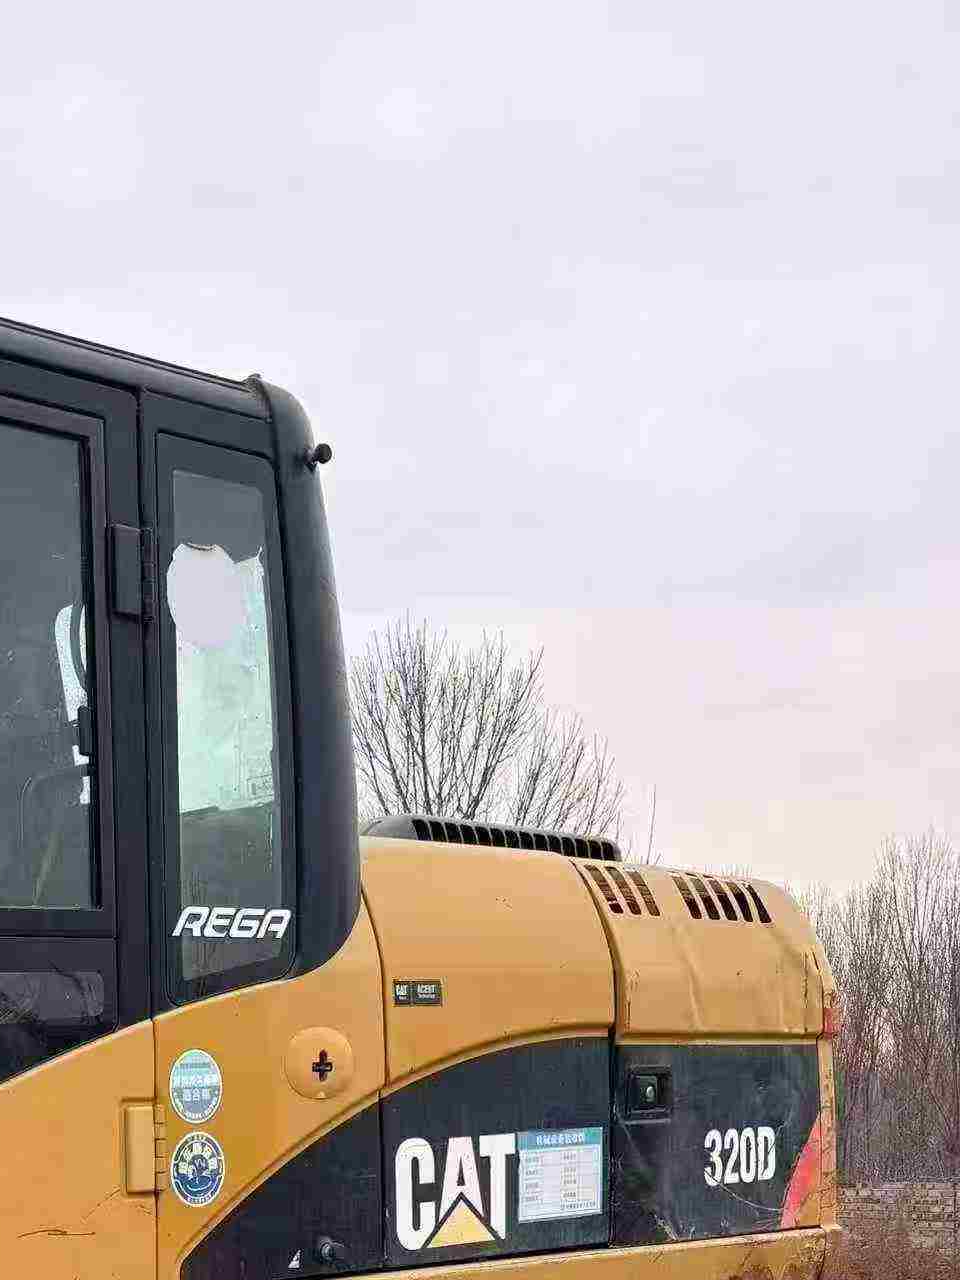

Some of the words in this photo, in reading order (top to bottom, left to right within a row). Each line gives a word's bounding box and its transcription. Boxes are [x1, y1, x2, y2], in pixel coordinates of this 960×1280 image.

[172, 906, 291, 938] REGA
[704, 1126, 776, 1187] 320D
[395, 1133, 515, 1251] CAT
